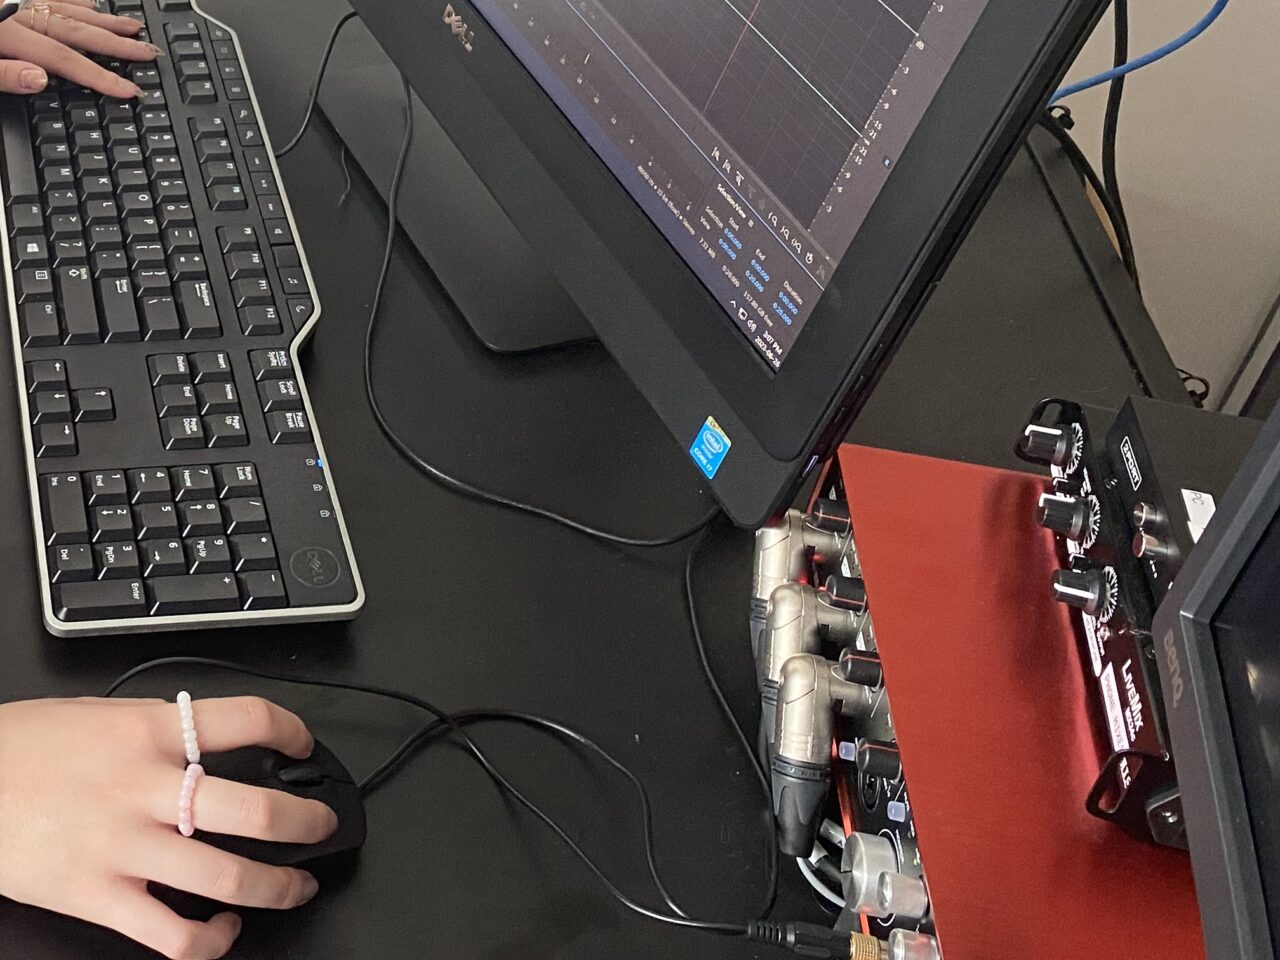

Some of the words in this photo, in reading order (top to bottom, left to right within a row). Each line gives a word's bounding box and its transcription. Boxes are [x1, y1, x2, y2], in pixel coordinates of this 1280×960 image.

[442, 3, 474, 52] DELL
[252, 253, 260, 263] F10
[756, 248, 766, 261] End
[784, 280, 802, 305] Duration
[258, 280, 267, 290] F11
[200, 282, 210, 306] Backspace
[266, 308, 275, 318] F12
[772, 342, 782, 355] PM
[218, 353, 226, 368] Insert
[183, 386, 192, 397] End
[225, 384, 233, 400] Home
[279, 382, 287, 393] Lock
[286, 381, 296, 396] Scroll
[183, 418, 191, 434] Down
[190, 418, 198, 432] Page
[225, 416, 232, 425] Up
[232, 416, 240, 429] Page
[286, 413, 295, 428] Break
[296, 412, 305, 428] Pause
[1123, 443, 1140, 483] 2PORT
[183, 470, 192, 487] Home
[237, 467, 245, 480] Lock
[244, 466, 252, 480] Num
[96, 475, 104, 487] End
[60, 549, 69, 560] Del
[105, 546, 115, 563] PgDn
[196, 540, 206, 557] PgUp
[131, 583, 140, 600] Enter
[1164, 628, 1184, 709] BenQ
